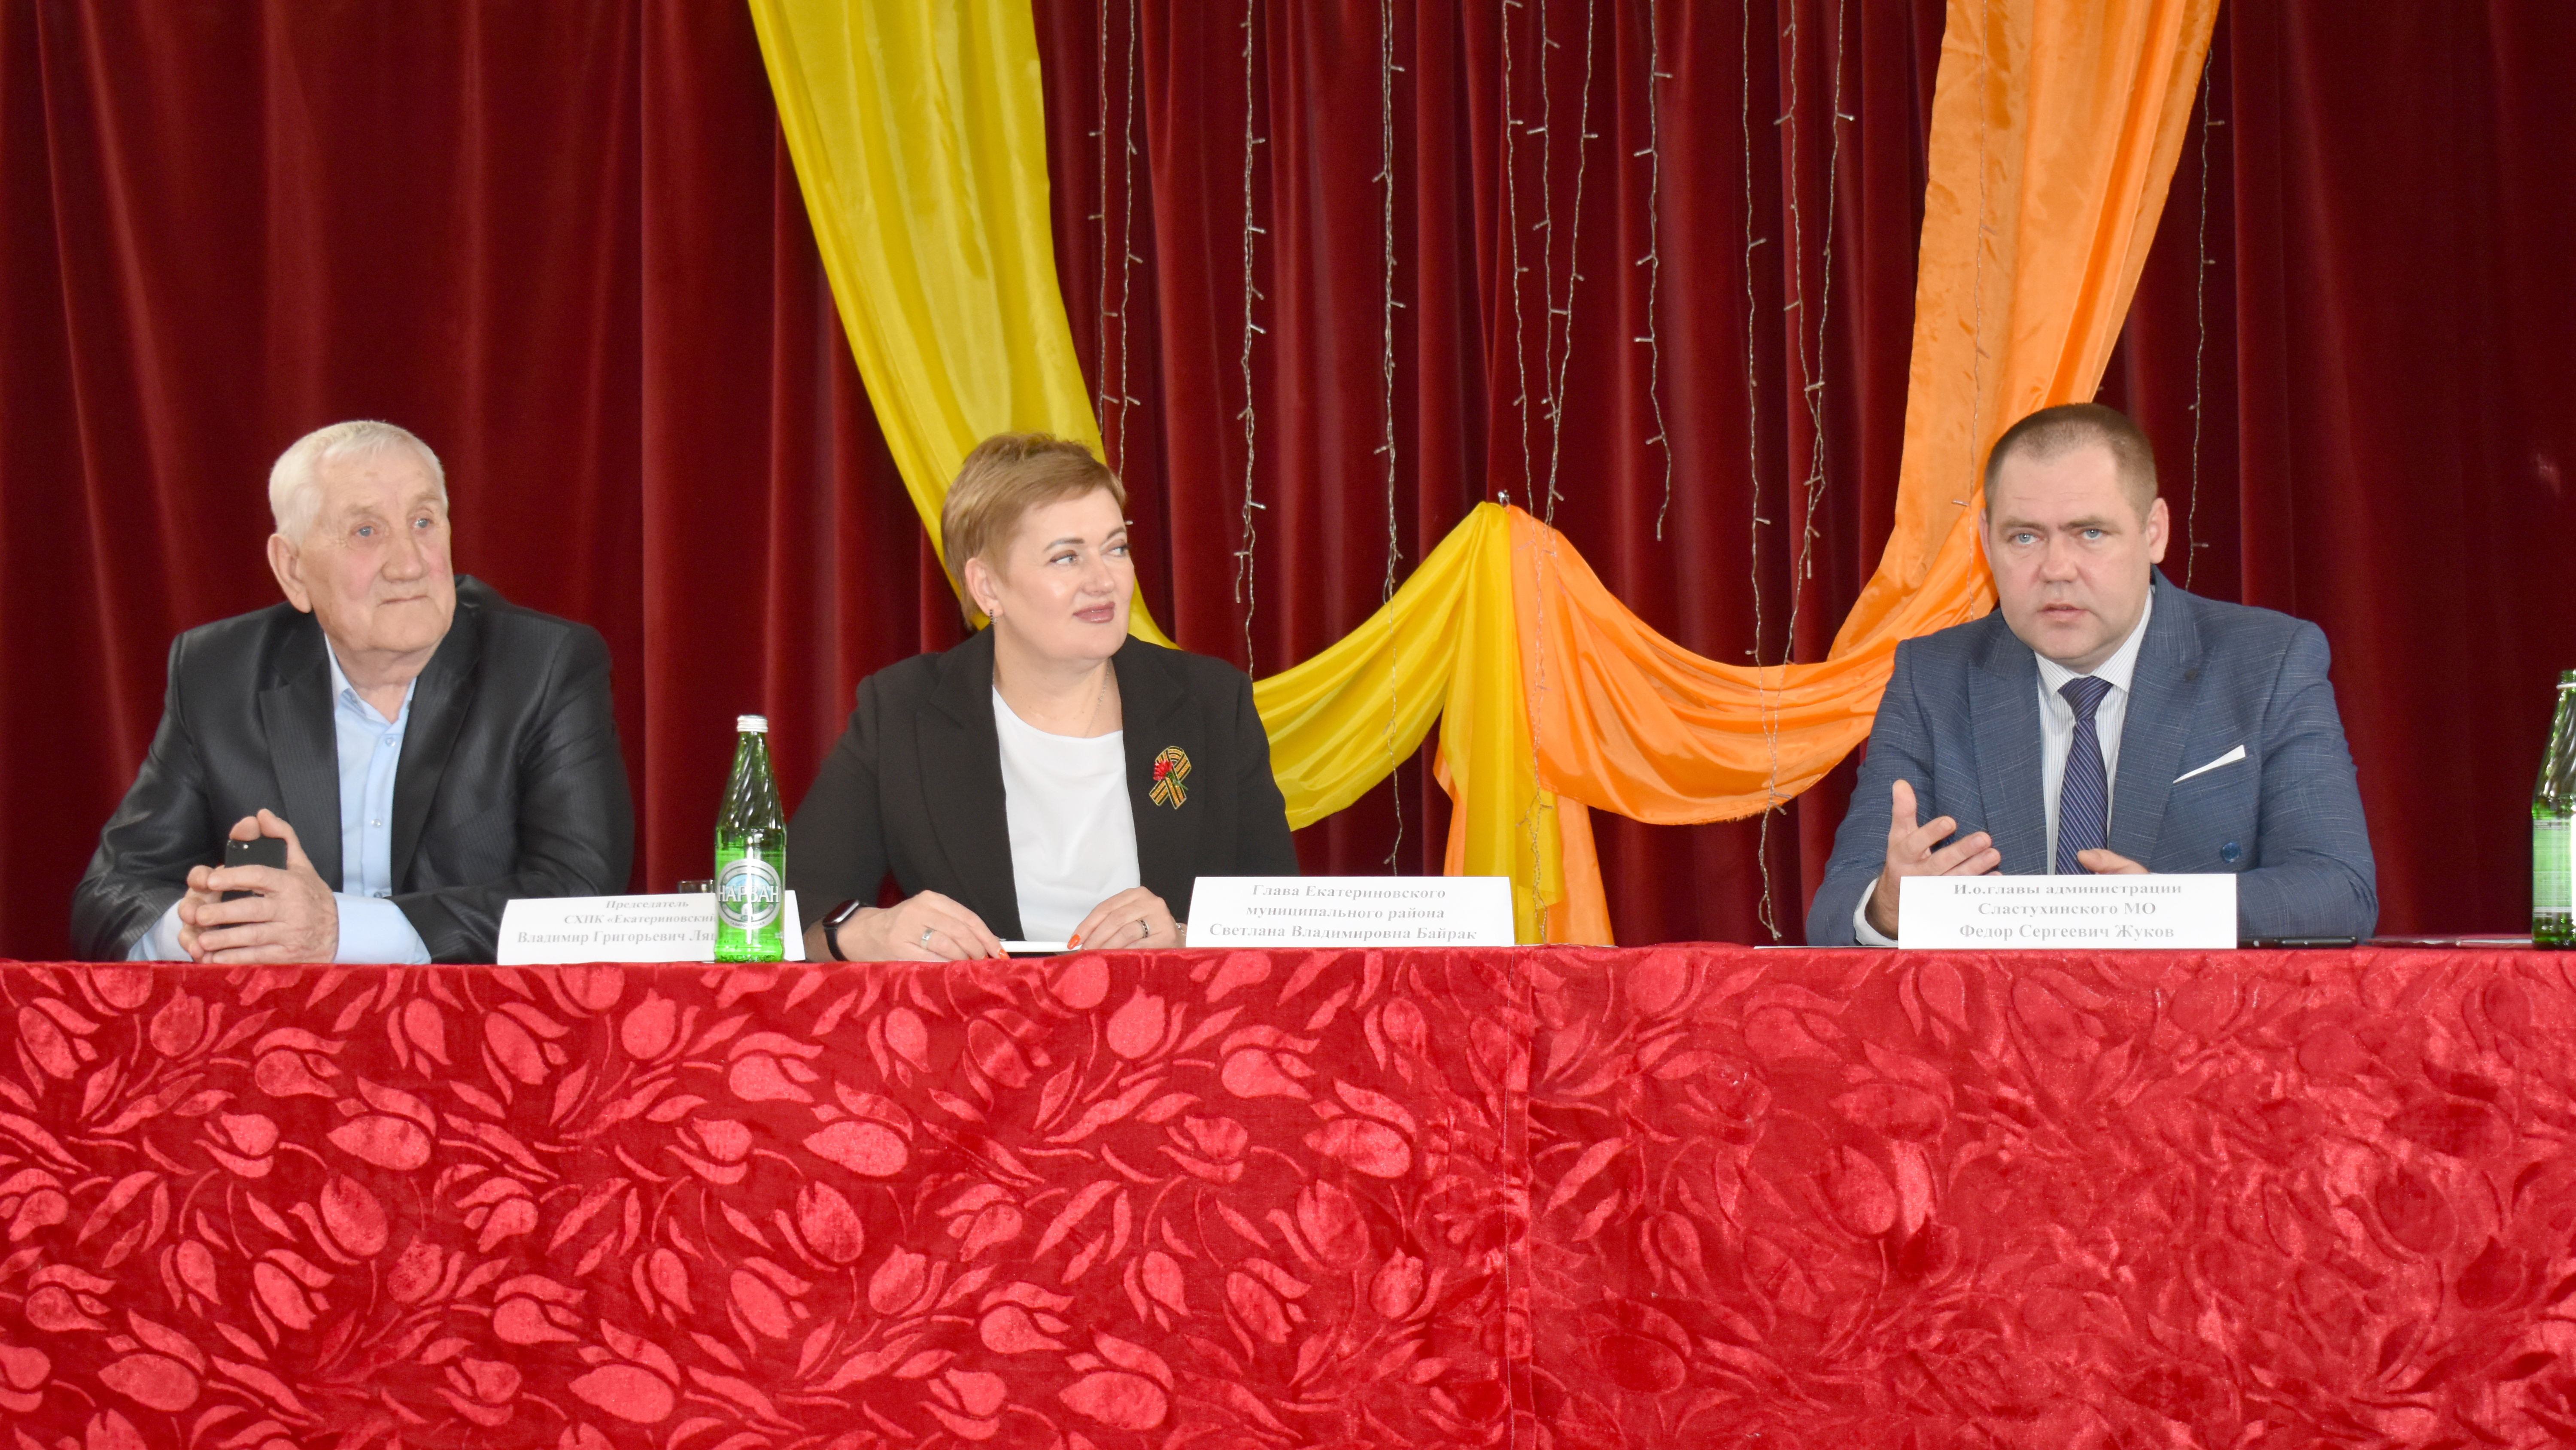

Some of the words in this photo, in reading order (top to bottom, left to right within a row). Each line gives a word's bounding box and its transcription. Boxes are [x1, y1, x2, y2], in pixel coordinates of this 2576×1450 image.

[1252, 884, 1300, 896] Глава
[1306, 885, 1446, 900] Екатериновского
[1954, 884, 2039, 894] И.о.главы
[2046, 885, 2181, 897] администрации
[606, 900, 689, 911] Председатель
[1978, 903, 2118, 918] Сластухинского
[2124, 903, 2156, 914] МО
[564, 915, 604, 924] СХПК
[1246, 907, 1383, 918] муниципального
[1388, 907, 1444, 921] района
[518, 931, 589, 945] Владимир
[593, 930, 686, 945] Григорьевич
[1209, 923, 1285, 936] Светлана
[1291, 925, 1410, 942] Владимировна
[1417, 927, 1477, 942] Байрак
[1959, 924, 2013, 941] Федор
[2019, 924, 2109, 941] Сергеевич
[2115, 924, 2174, 941] Жуков
